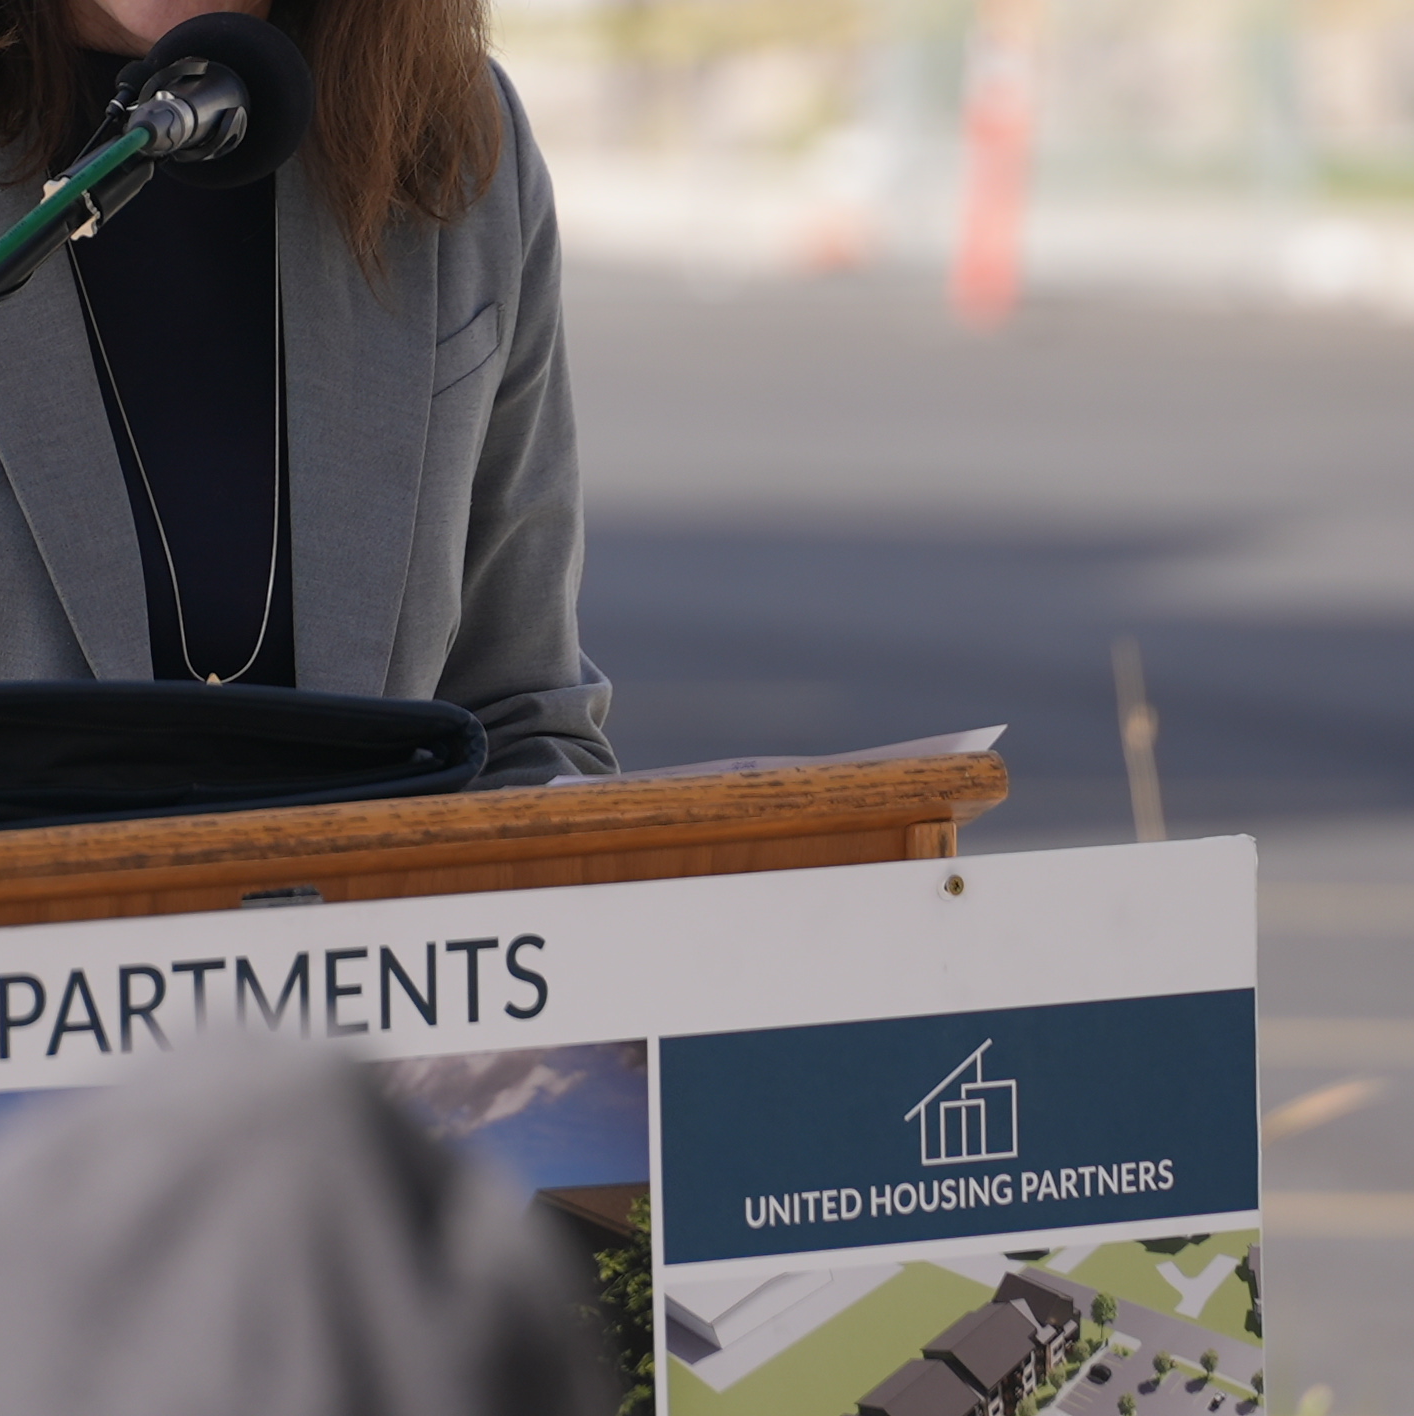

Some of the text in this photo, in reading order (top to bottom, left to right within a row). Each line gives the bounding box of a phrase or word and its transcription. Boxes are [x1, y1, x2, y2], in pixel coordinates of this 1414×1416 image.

[744, 1158, 1175, 1230] UNITED HOUSING PARTNERS
